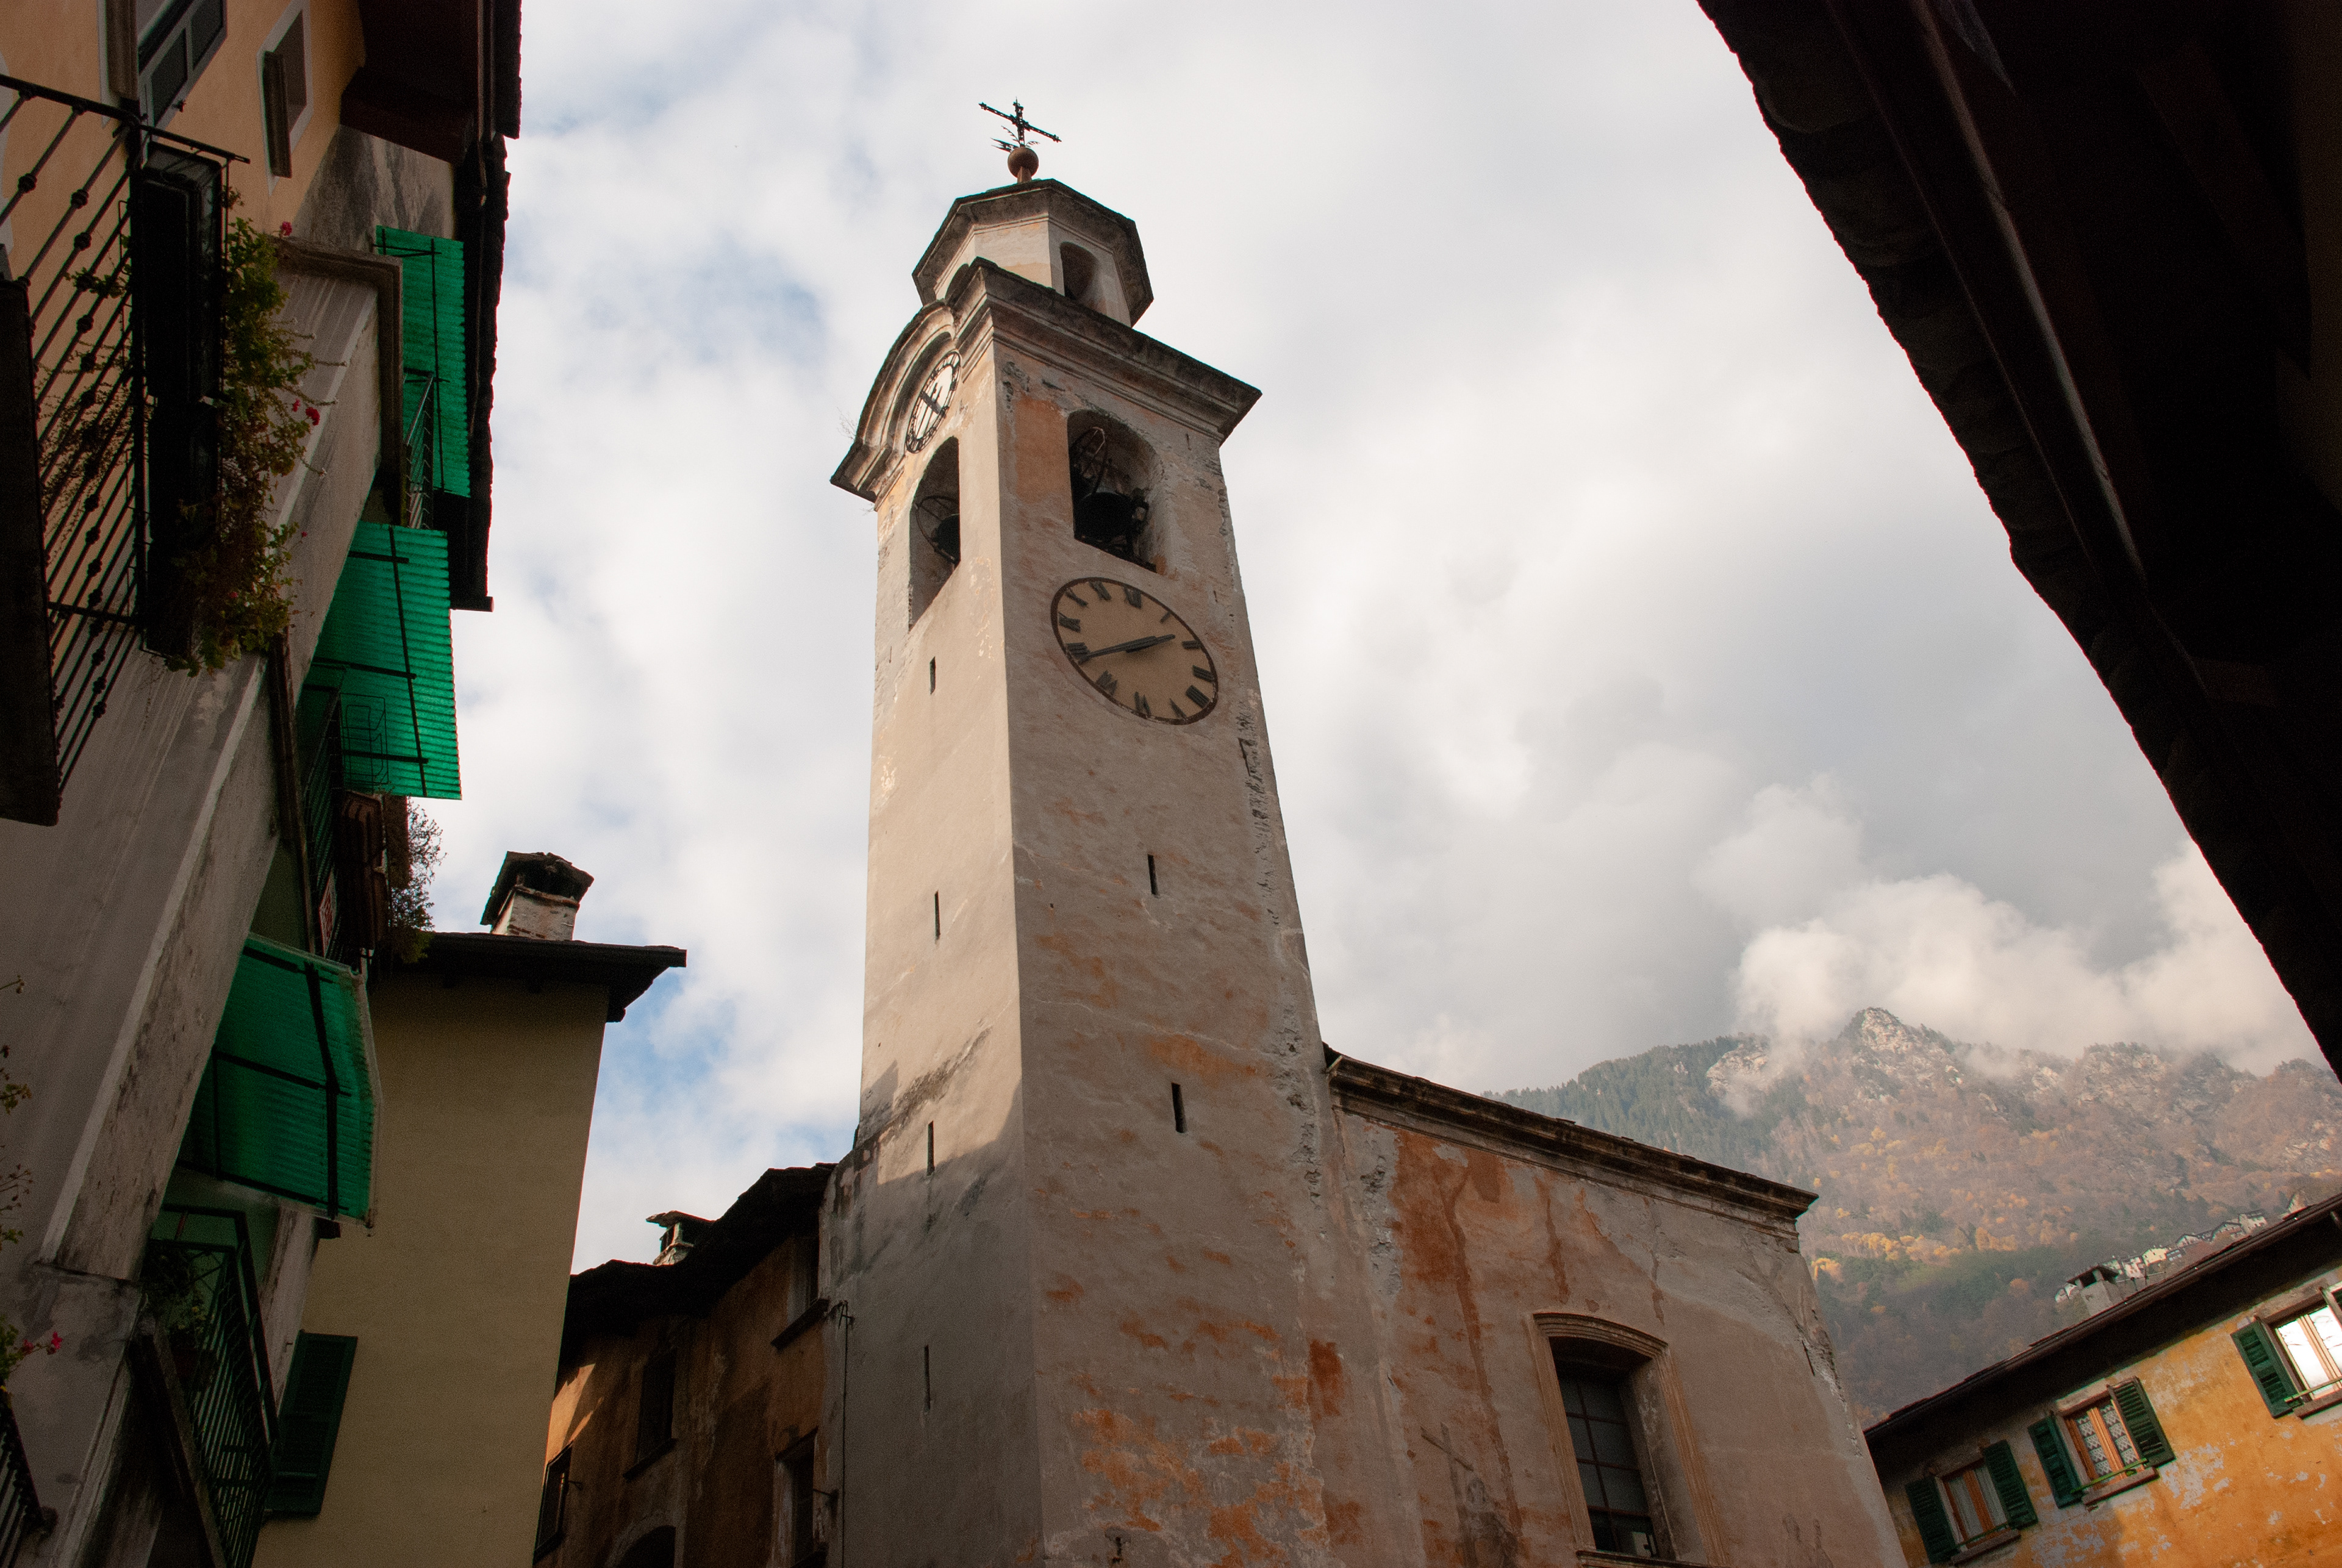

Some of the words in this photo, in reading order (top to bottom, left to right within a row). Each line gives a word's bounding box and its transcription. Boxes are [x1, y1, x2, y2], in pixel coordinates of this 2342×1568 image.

[1160, 611, 1172, 625] I
[1181, 640, 1202, 650] II
[1192, 664, 1216, 683] III
